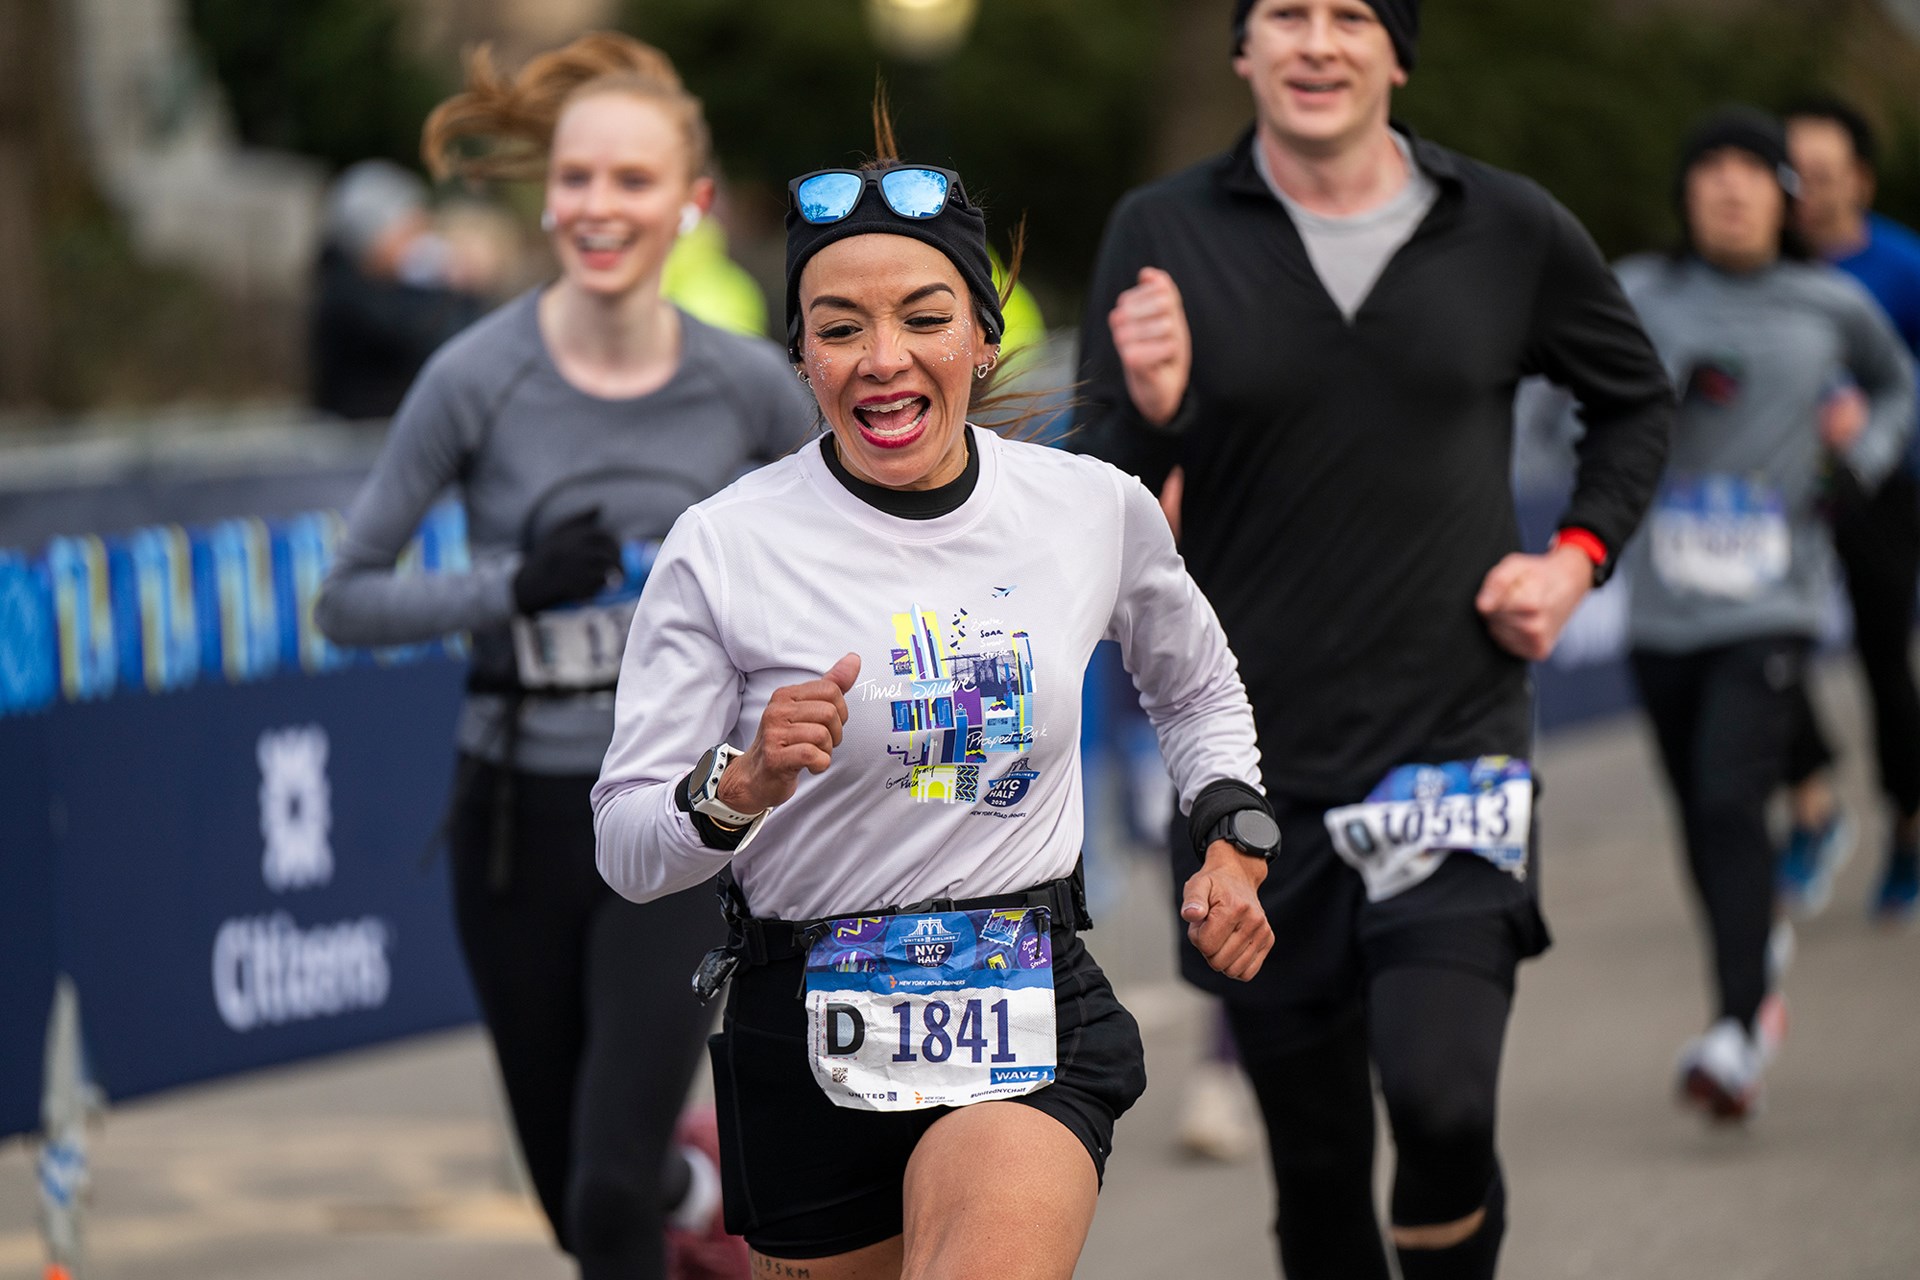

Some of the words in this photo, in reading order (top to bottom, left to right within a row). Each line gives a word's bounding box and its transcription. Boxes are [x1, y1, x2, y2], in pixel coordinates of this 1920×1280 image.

[855, 679, 903, 701] Times
[912, 671, 977, 704] Square
[967, 730, 1018, 749] Prospect
[1018, 723, 1048, 742] Park
[989, 790, 1016, 799] HALF
[993, 811, 1008, 819] ROAD
[914, 944, 946, 957] NYC
[917, 954, 943, 964] HALF
[826, 1003, 866, 1055] D
[892, 999, 1017, 1063] 1841
[995, 1071, 1039, 1081] WAVE
[848, 1091, 885, 1099] UNITED
[970, 1087, 1027, 1098] #UnitedNYCHalf
